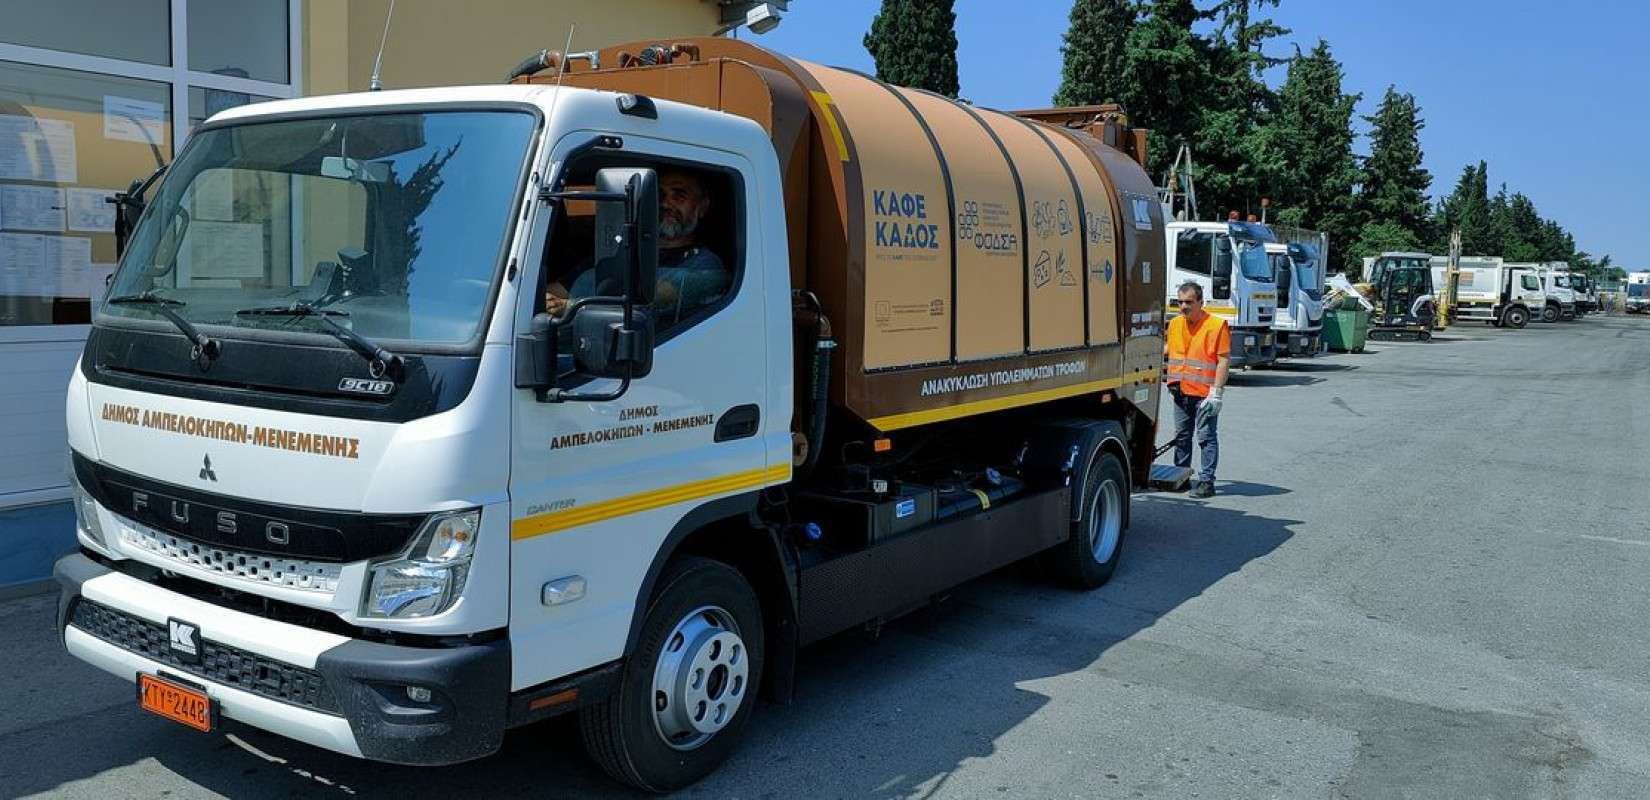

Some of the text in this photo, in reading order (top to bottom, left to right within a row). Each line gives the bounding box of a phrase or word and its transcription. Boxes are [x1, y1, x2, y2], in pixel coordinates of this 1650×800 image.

[874, 190, 927, 219] ΚΑΦΕ
[876, 221, 939, 249] ΚΑΔΟΣ
[920, 360, 1086, 396] ΑΝΑΚΥΚΛΩΣΗ ΥΠΟΛΕΙΜΜΑΤΩΝ ΤΡΟΦΩΝ
[101, 403, 140, 425] ΔΗΜΟΣ
[619, 405, 659, 421] ΔΗΜΟΣ
[550, 424, 644, 449] ΑΜΠΕΛΟΚΗΠΩΝ
[653, 414, 715, 434] ΜΕΝΕΜΕΝΗΣ
[132, 491, 290, 546] FUSO
